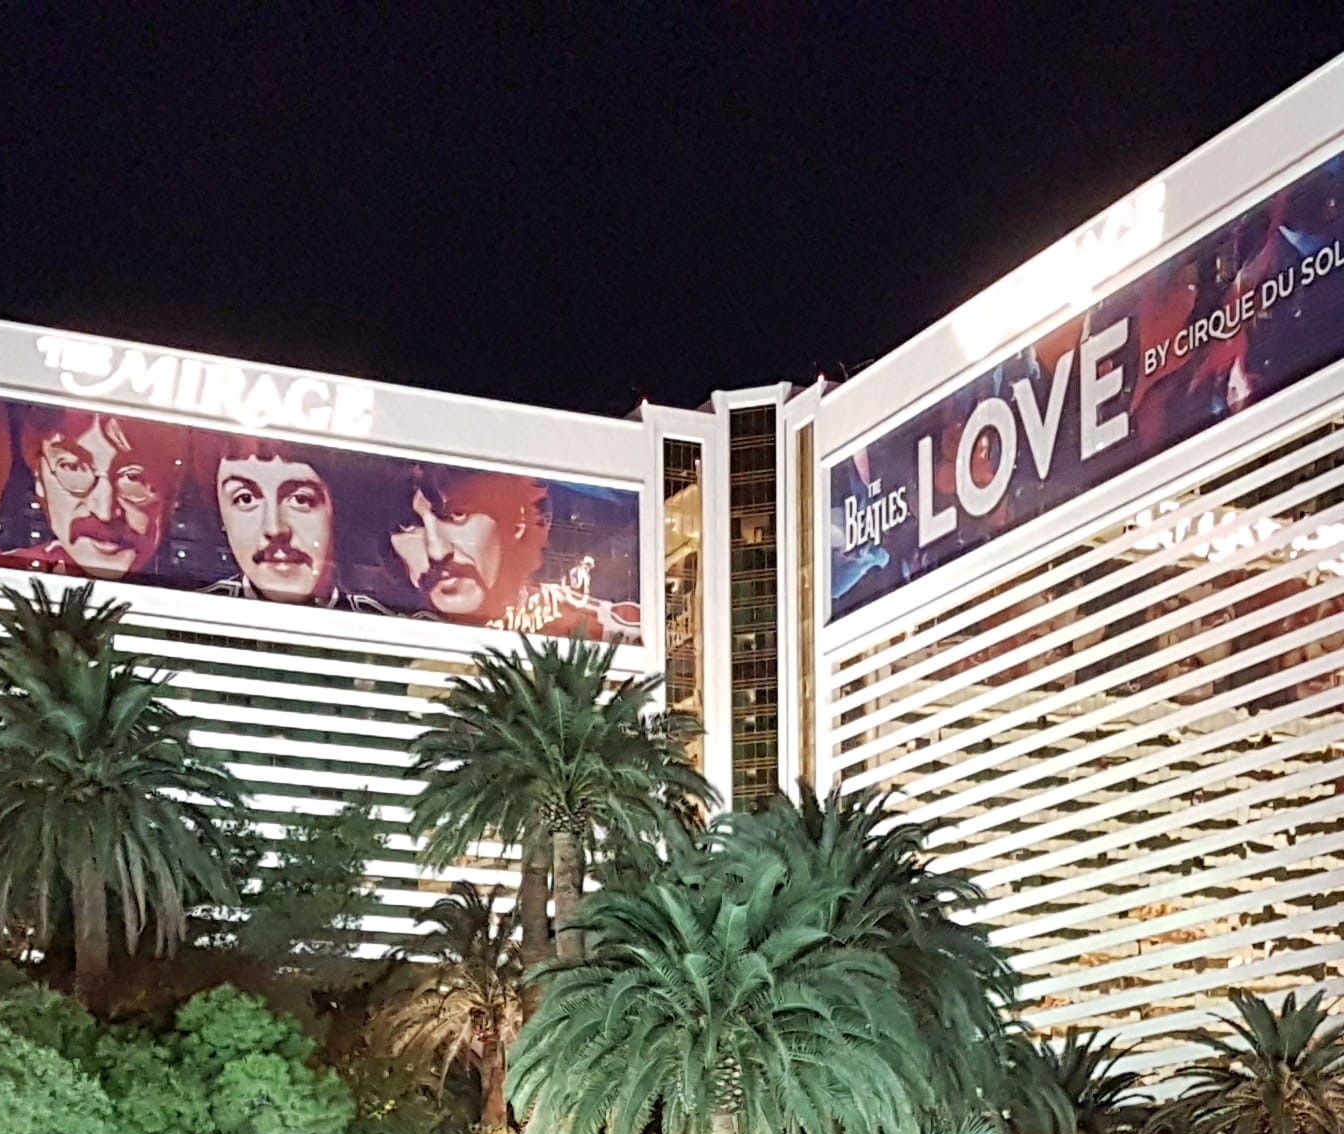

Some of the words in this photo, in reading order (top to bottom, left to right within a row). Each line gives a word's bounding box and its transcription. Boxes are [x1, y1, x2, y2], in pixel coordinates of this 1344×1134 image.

[1144, 338, 1171, 375] BY
[1173, 289, 1255, 356] CIRQUE
[1262, 267, 1294, 309] DU
[60, 350, 375, 435] MIRAGE
[918, 317, 1129, 549] LOVE
[843, 486, 908, 553] BEATLES
